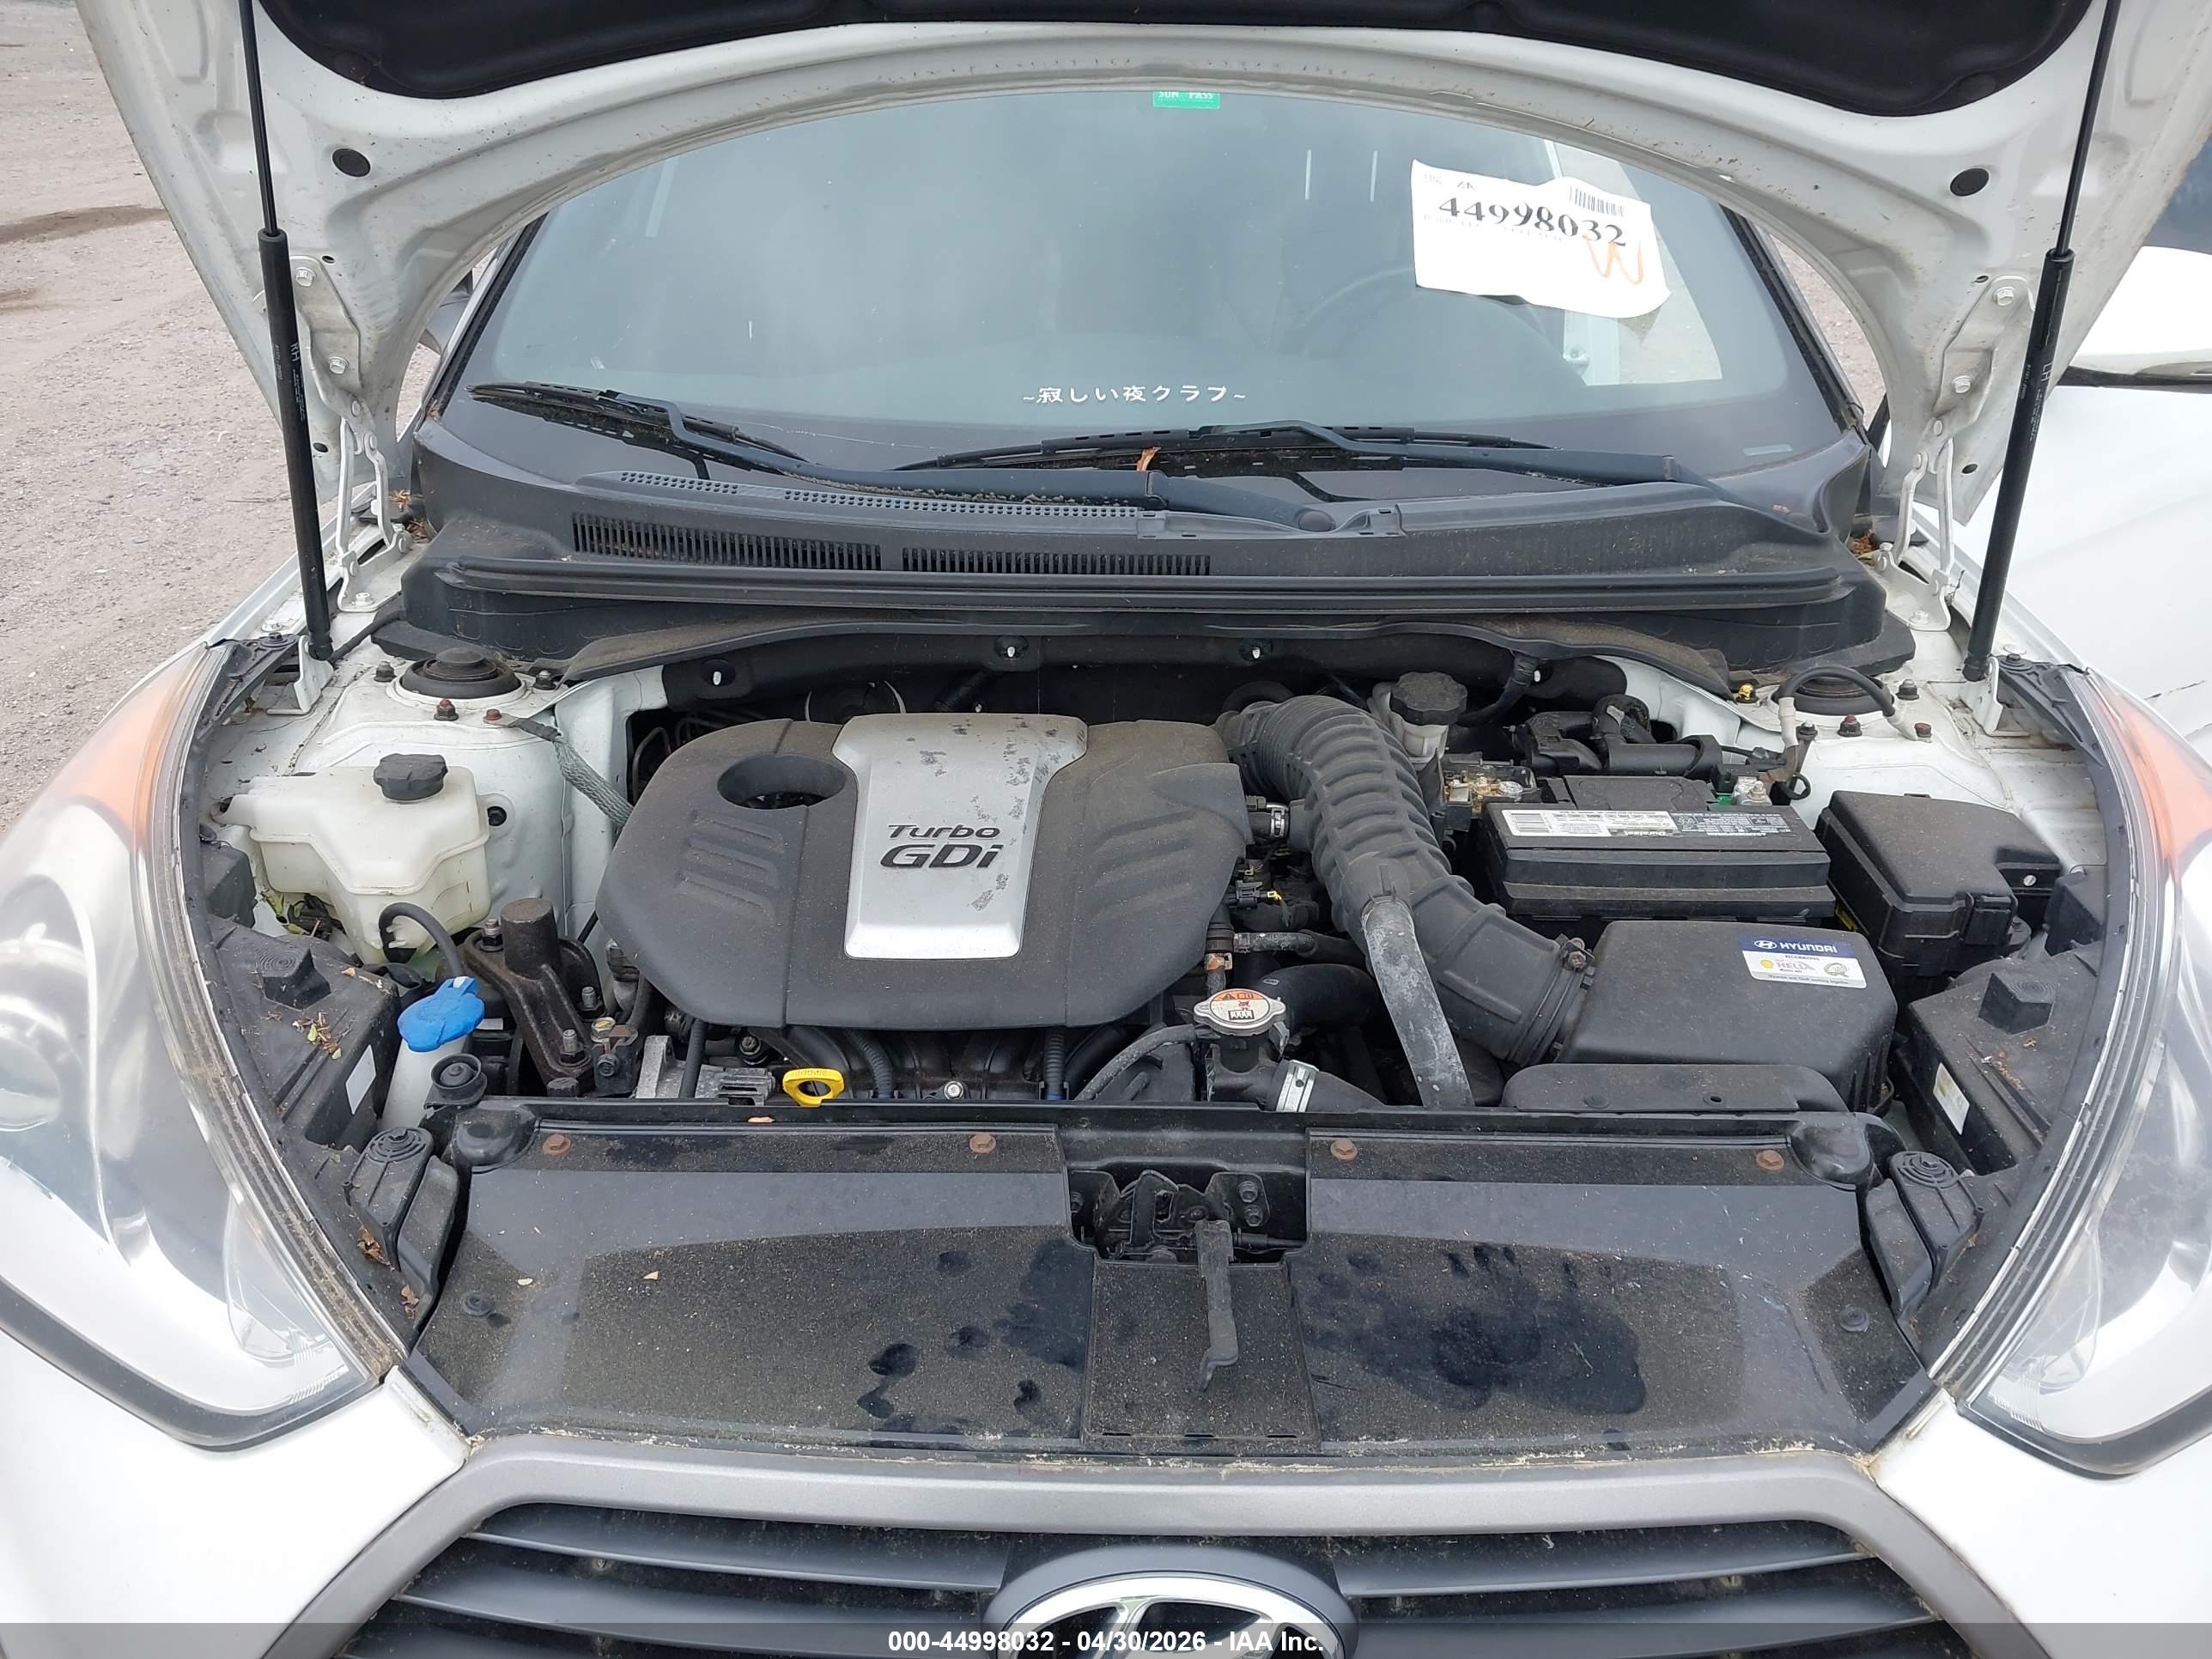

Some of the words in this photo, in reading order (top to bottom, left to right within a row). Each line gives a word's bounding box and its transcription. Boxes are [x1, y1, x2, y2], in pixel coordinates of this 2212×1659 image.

[1438, 197, 1626, 247] 44998032
[2040, 361, 2053, 382] LH
[887, 823, 1001, 839] Turbo
[879, 843, 1005, 869] GDi
[1780, 942, 1837, 953] HYUNDAI
